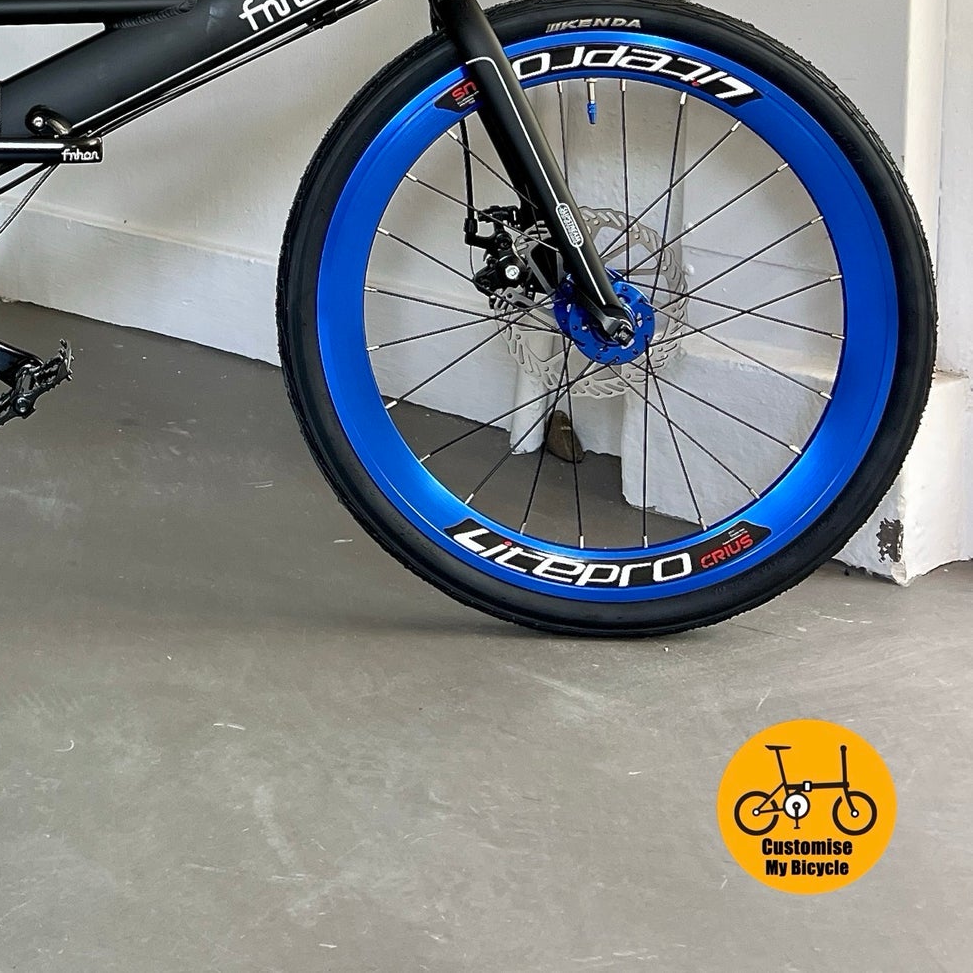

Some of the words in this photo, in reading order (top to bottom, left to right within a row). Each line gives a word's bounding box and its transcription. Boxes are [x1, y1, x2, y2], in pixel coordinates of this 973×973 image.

[557, 17, 642, 30] KENDA
[61, 148, 100, 162] fnhon
[453, 528, 693, 587] Litepro
[700, 534, 754, 569] CRIUS
